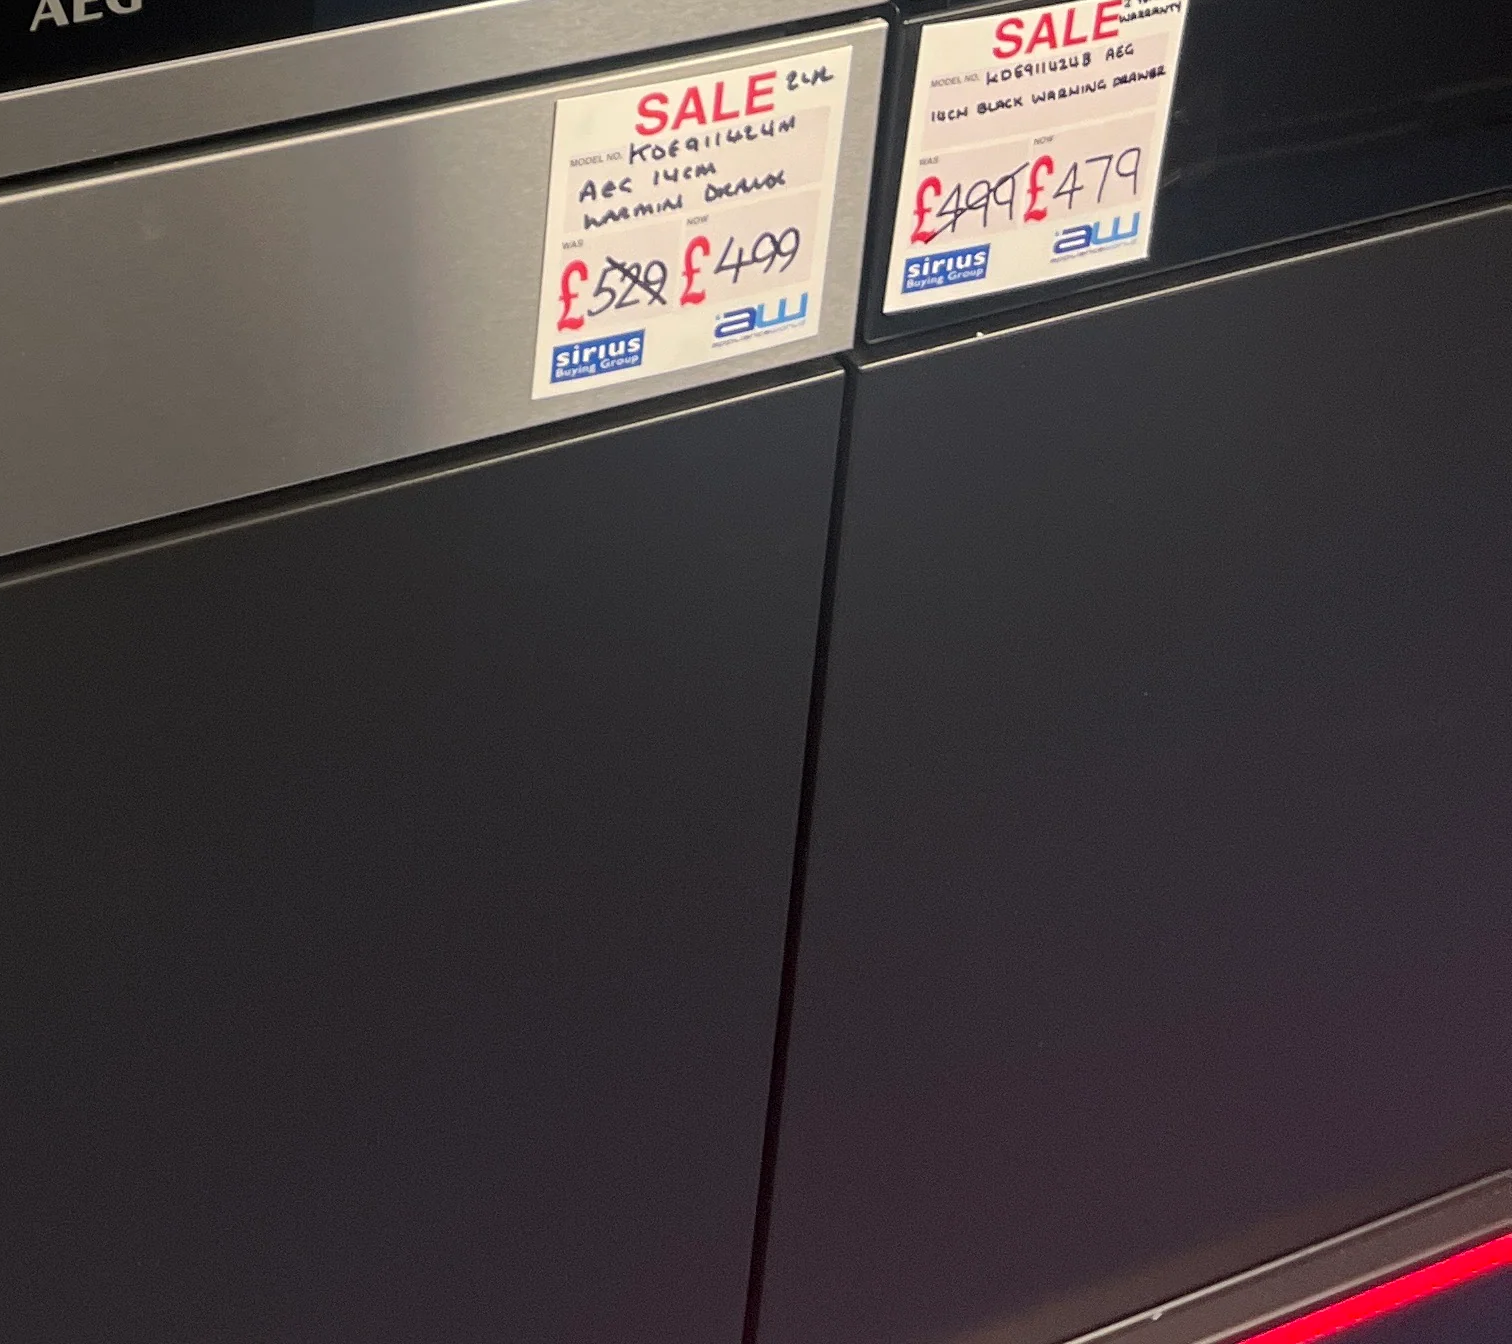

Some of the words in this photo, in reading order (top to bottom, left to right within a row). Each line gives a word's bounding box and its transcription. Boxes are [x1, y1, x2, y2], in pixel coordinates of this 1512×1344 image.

[634, 70, 778, 137] SALE
[907, 249, 987, 279] sirius
[555, 336, 641, 368] sirius
